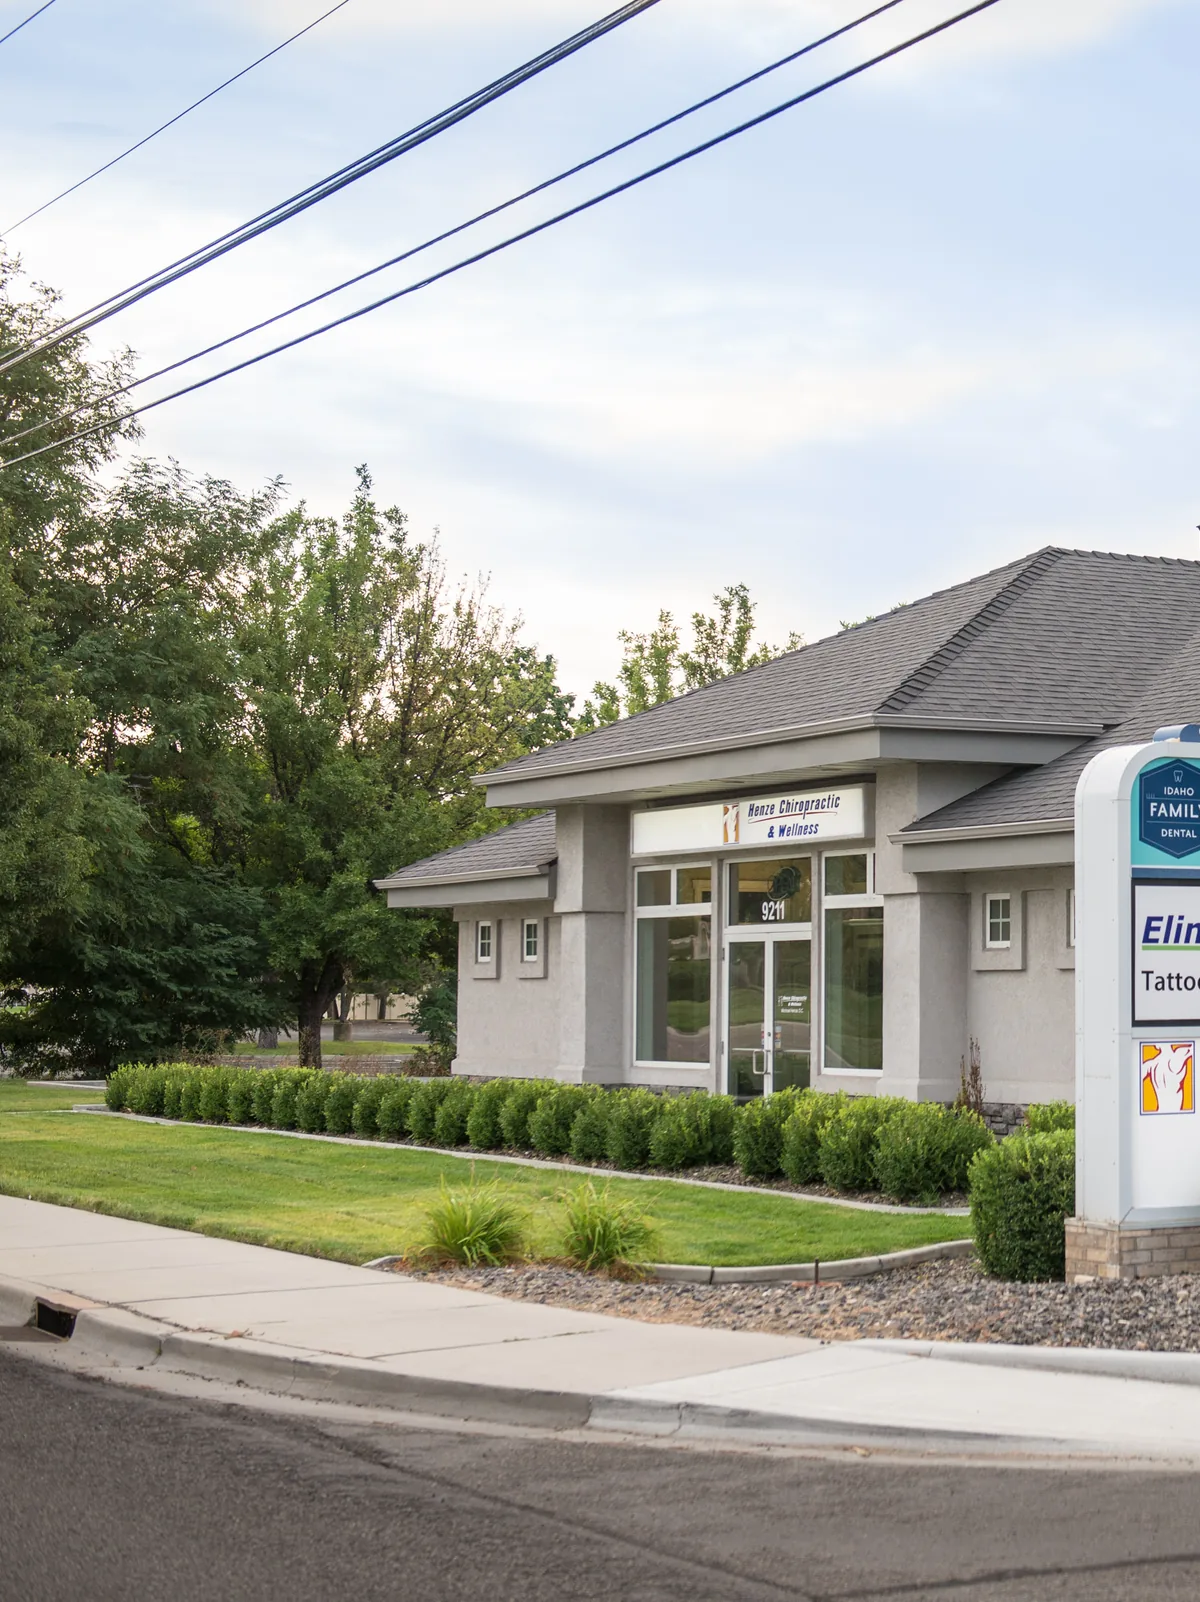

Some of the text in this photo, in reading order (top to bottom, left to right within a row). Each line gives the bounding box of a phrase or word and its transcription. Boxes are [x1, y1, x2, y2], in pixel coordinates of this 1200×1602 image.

[1164, 786, 1194, 796] IDAHO
[748, 794, 840, 820] Henze Chiropractic
[768, 823, 819, 838] & Wellness
[1161, 828, 1197, 838] DENTAL
[761, 901, 786, 921] 9211
